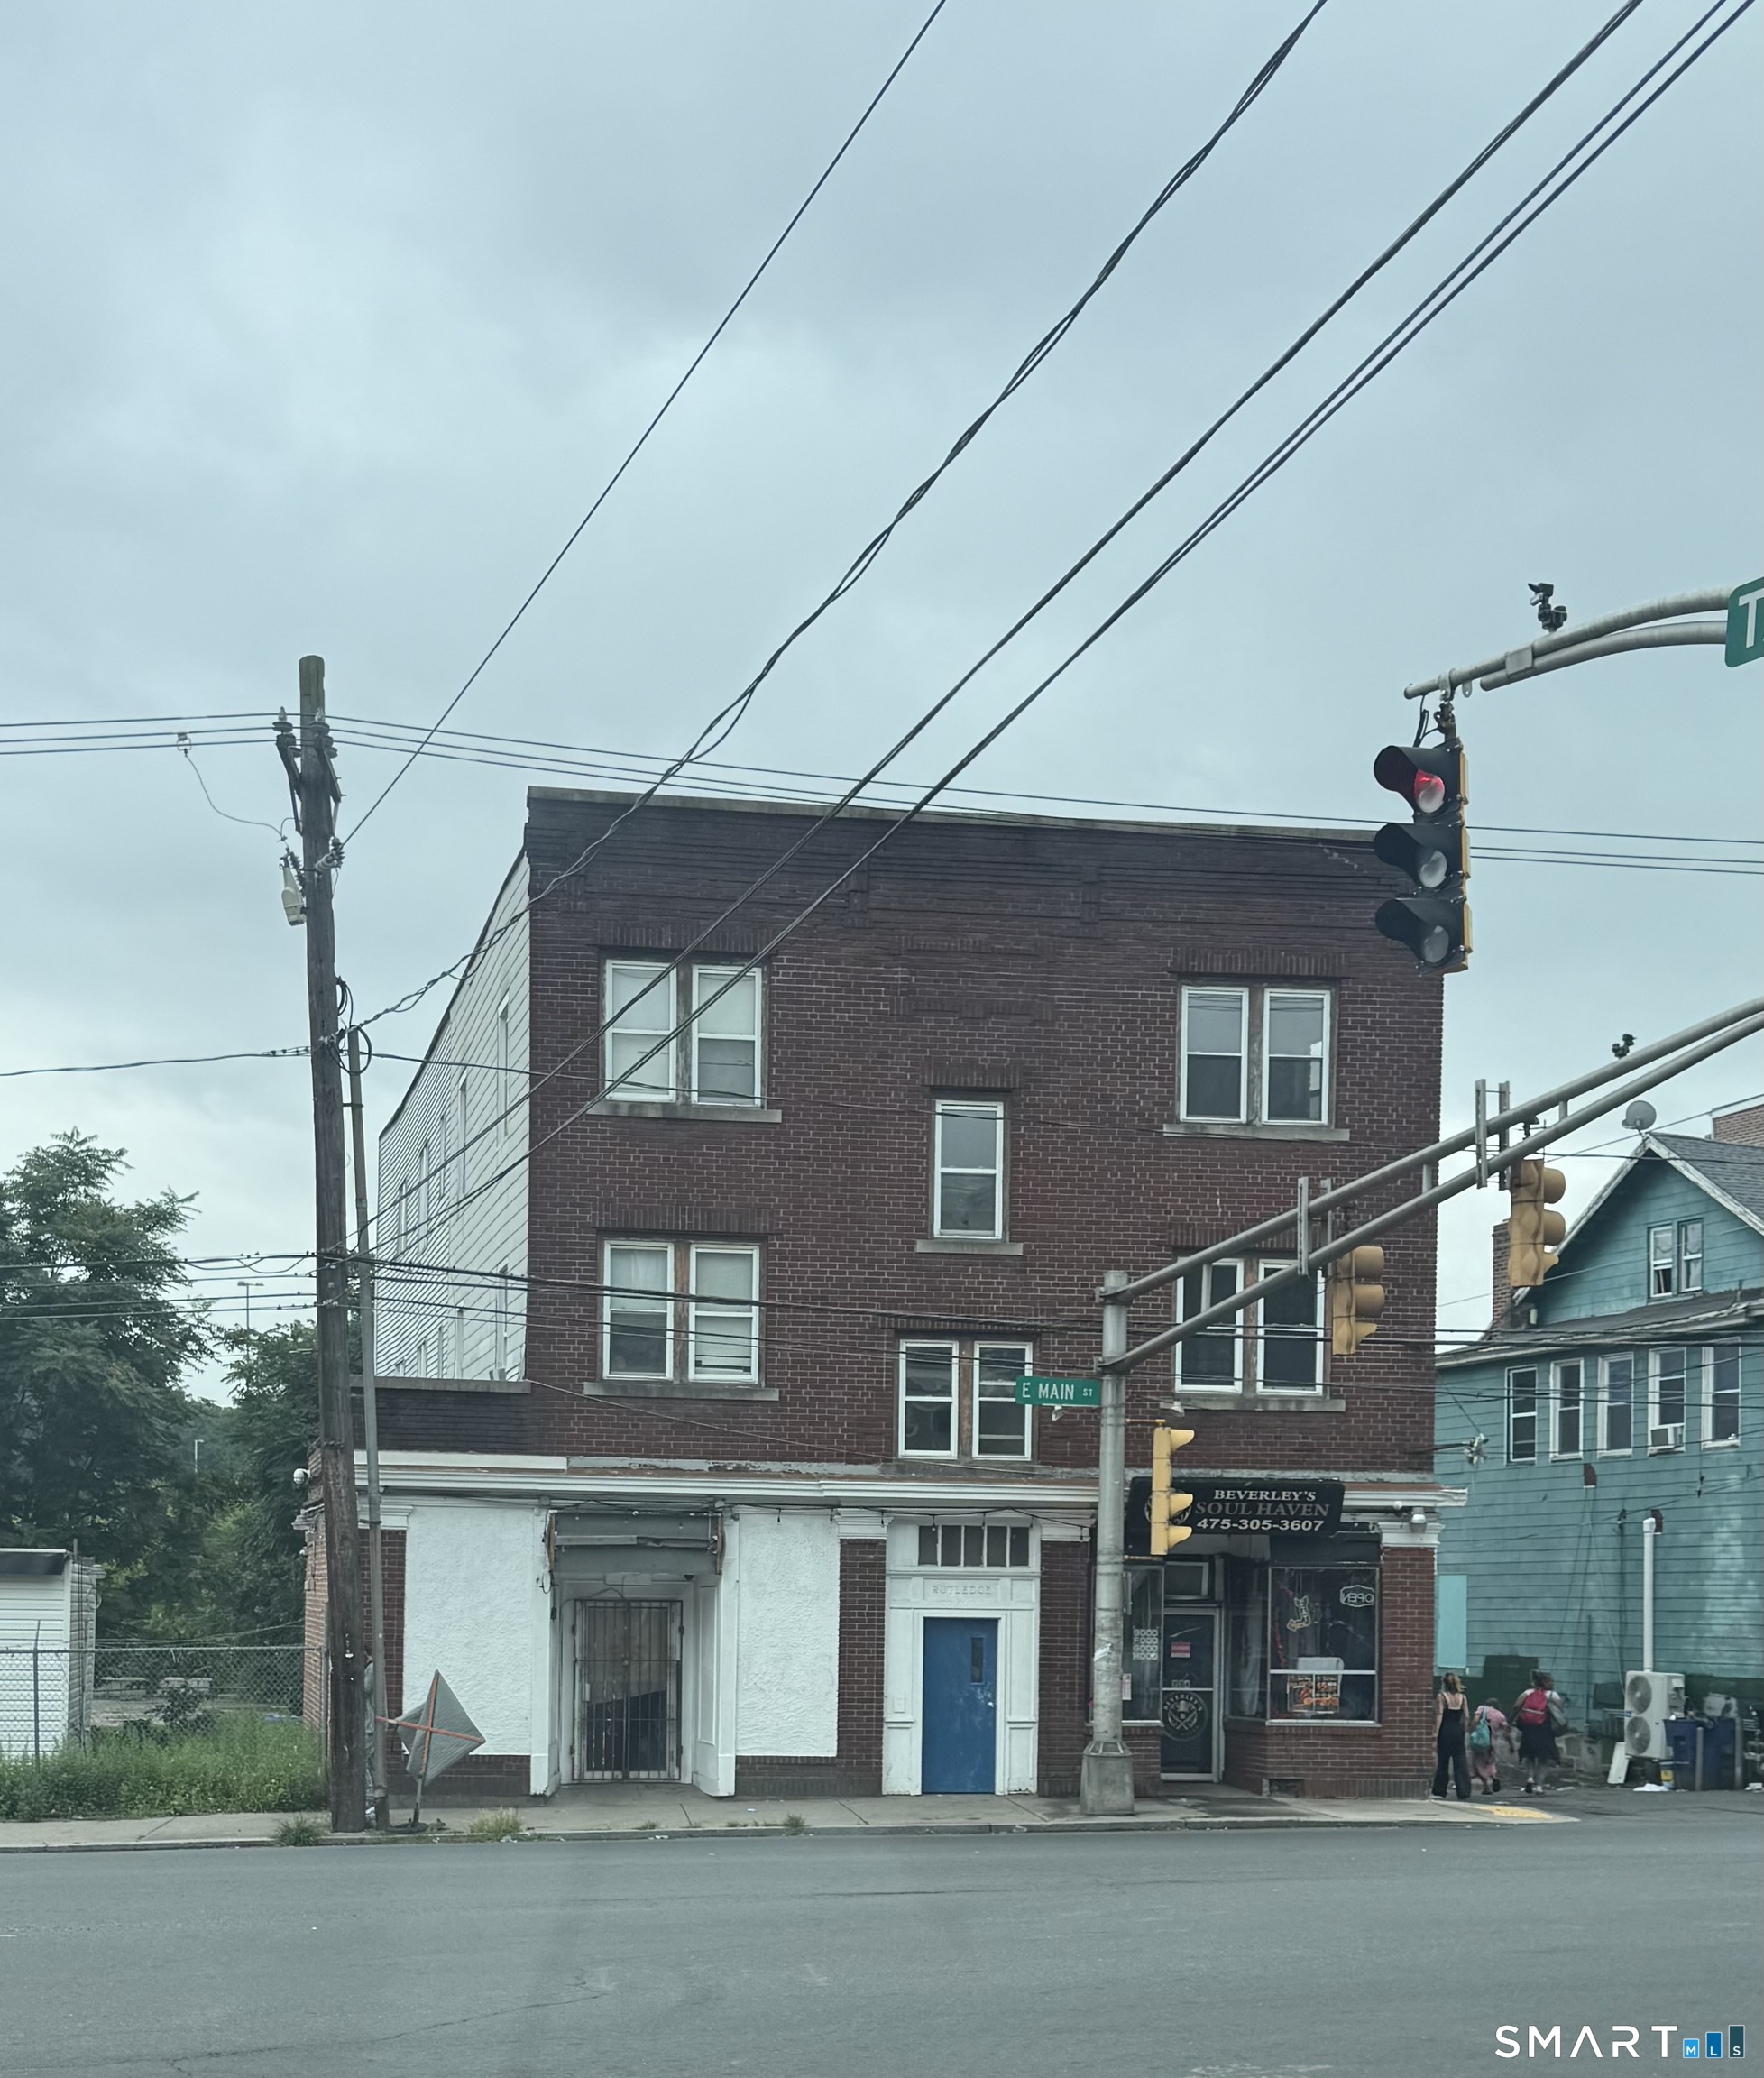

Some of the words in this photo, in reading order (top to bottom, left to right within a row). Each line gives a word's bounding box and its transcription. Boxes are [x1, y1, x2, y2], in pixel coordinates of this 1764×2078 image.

[1738, 587, 1764, 648] T
[1022, 1382, 1031, 1398] E
[1038, 1383, 1074, 1400] MAIN
[1082, 1388, 1093, 1397] ST
[1213, 1490, 1317, 1502] BEVERLEY'S
[1195, 1502, 1253, 1515] SOUL
[1255, 1503, 1330, 1517] HAVEN
[1197, 1518, 1325, 1531] 475-305-3607
[1133, 1629, 1159, 1637] GOOD
[1133, 1644, 1159, 1652] GOOD
